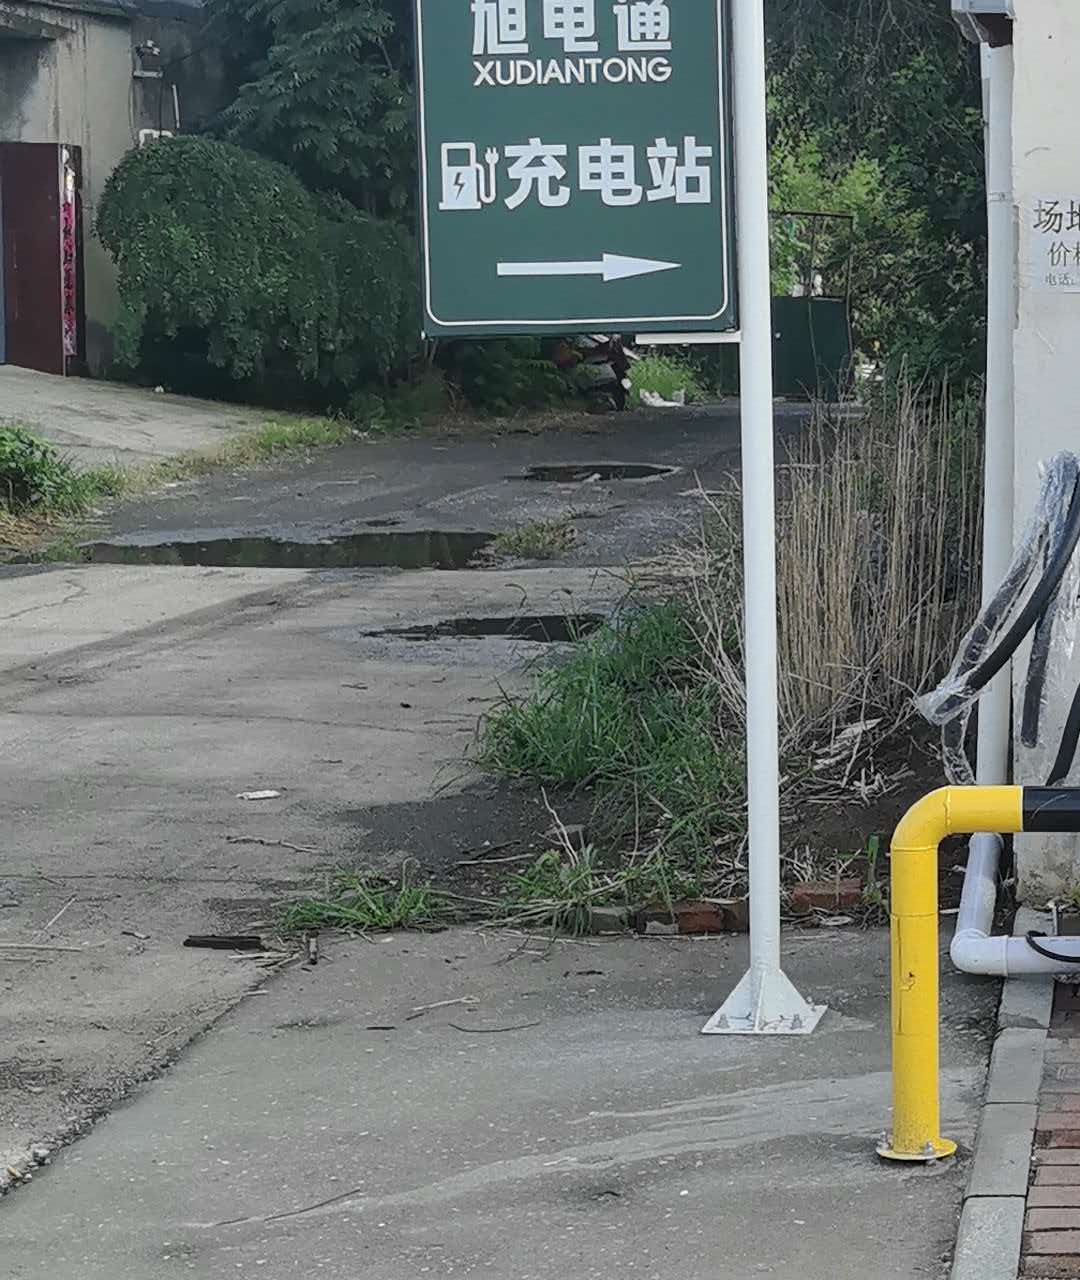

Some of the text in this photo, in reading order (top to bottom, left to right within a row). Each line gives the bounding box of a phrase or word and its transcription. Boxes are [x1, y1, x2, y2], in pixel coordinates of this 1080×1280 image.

[472, 57, 672, 86] XUDIANTONG
[504, 135, 713, 210] 充电站
